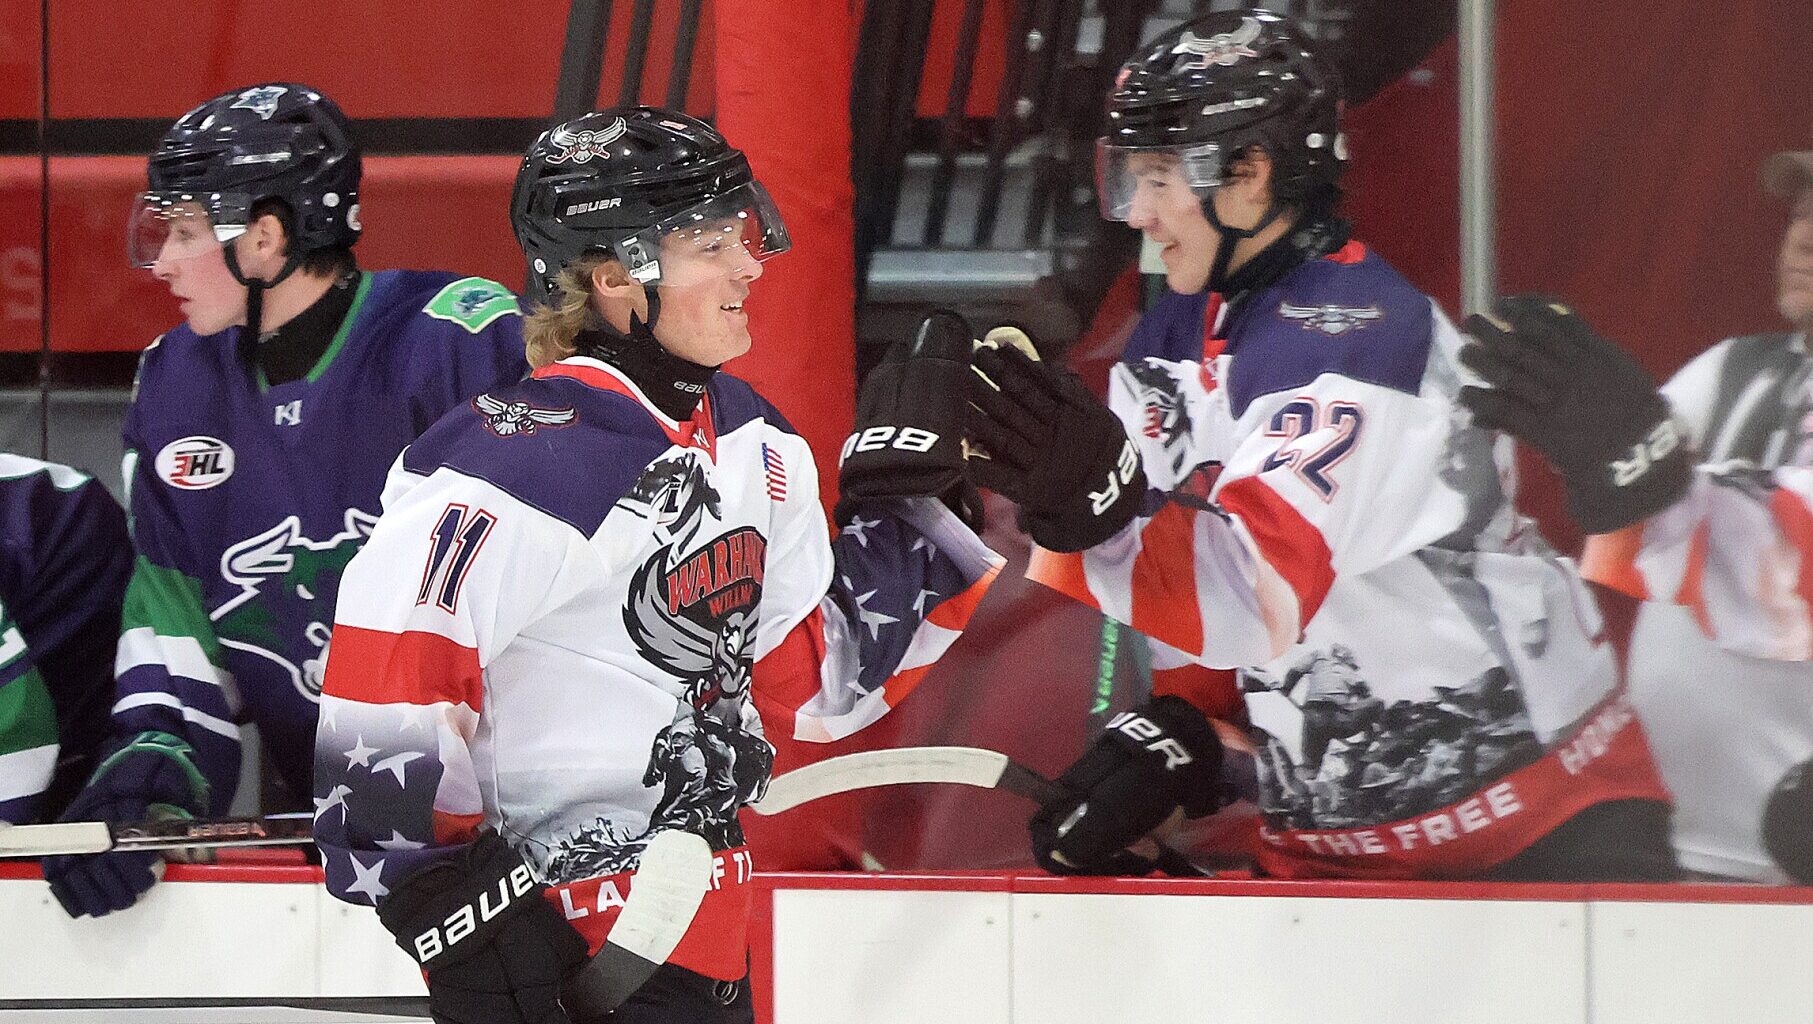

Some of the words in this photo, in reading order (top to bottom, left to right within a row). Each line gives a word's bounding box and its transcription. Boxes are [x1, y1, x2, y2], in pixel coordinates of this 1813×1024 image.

[565, 197, 622, 216] BAUER
[1256, 396, 1365, 505] 22
[415, 503, 498, 616] 11
[1296, 830, 1388, 856] THE
[1391, 782, 1524, 850] FREE
[414, 861, 538, 963] BAUE
[560, 878, 634, 920] LA
